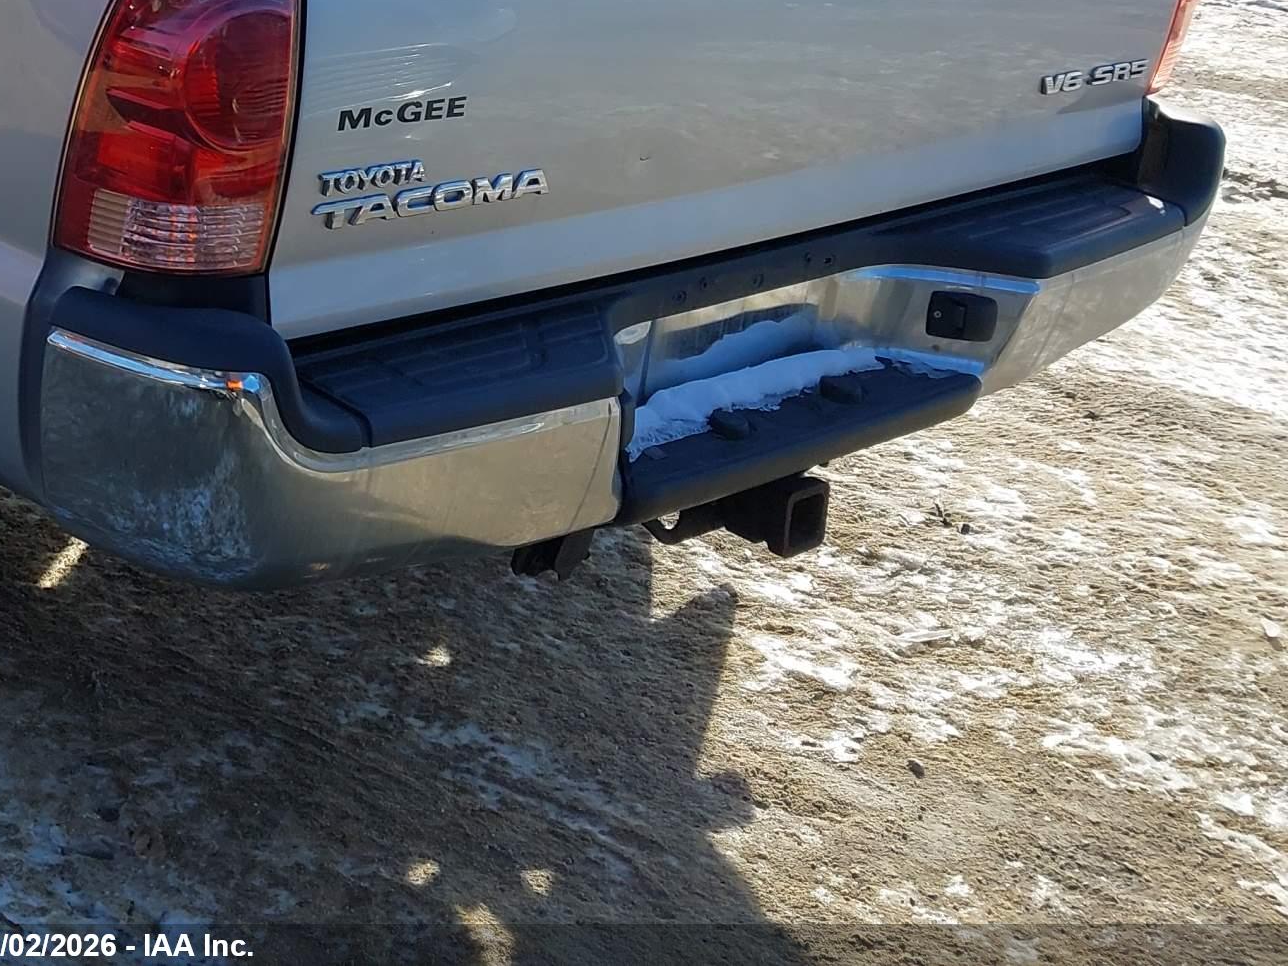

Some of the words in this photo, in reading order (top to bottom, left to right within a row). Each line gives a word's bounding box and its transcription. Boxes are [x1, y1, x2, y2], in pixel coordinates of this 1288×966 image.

[1041, 71, 1083, 95] V6
[1087, 59, 1149, 86] SR5
[337, 96, 467, 131] McGEE
[318, 159, 426, 196] TOYOTA
[311, 168, 550, 229] TACOMA
